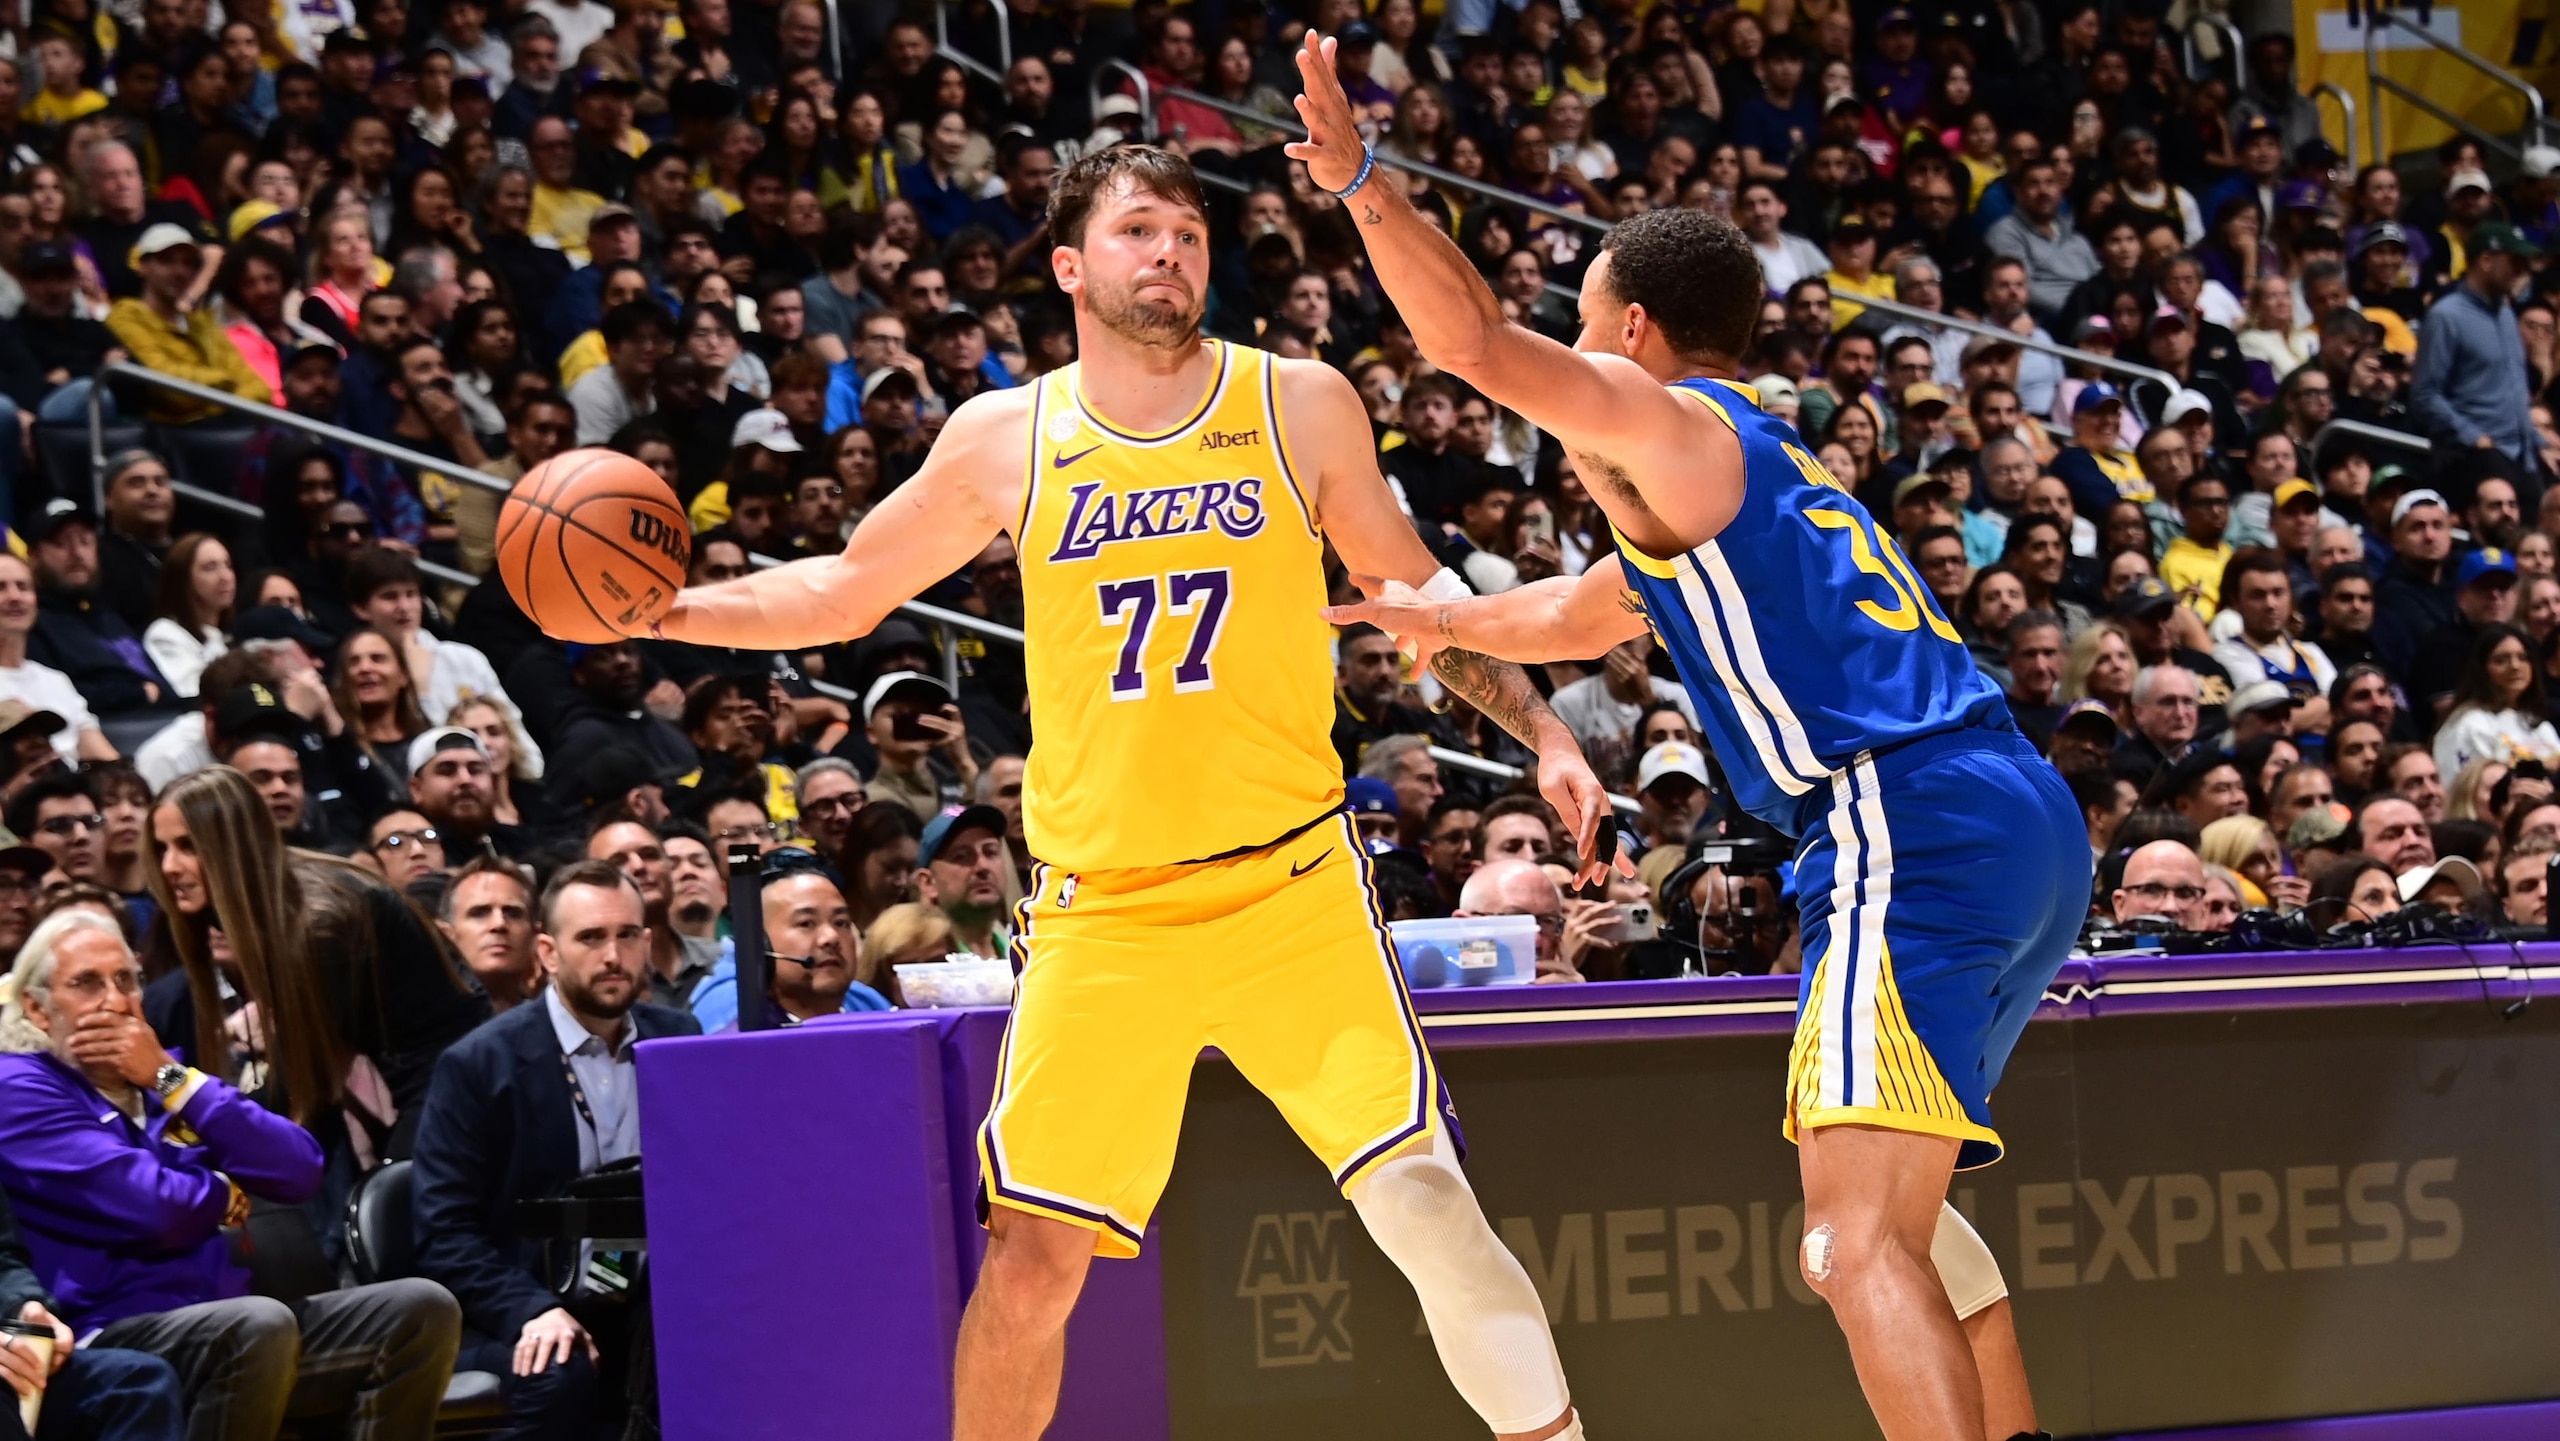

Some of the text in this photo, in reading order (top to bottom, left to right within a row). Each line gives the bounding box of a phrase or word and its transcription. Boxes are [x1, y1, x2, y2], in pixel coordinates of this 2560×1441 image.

[1198, 428, 1260, 451] Albert
[1047, 479, 1269, 565] LAKERS
[1096, 567, 1233, 702] 77
[2017, 1158, 2463, 1290] EXPRESS
[1255, 1288, 1353, 1368] EX
